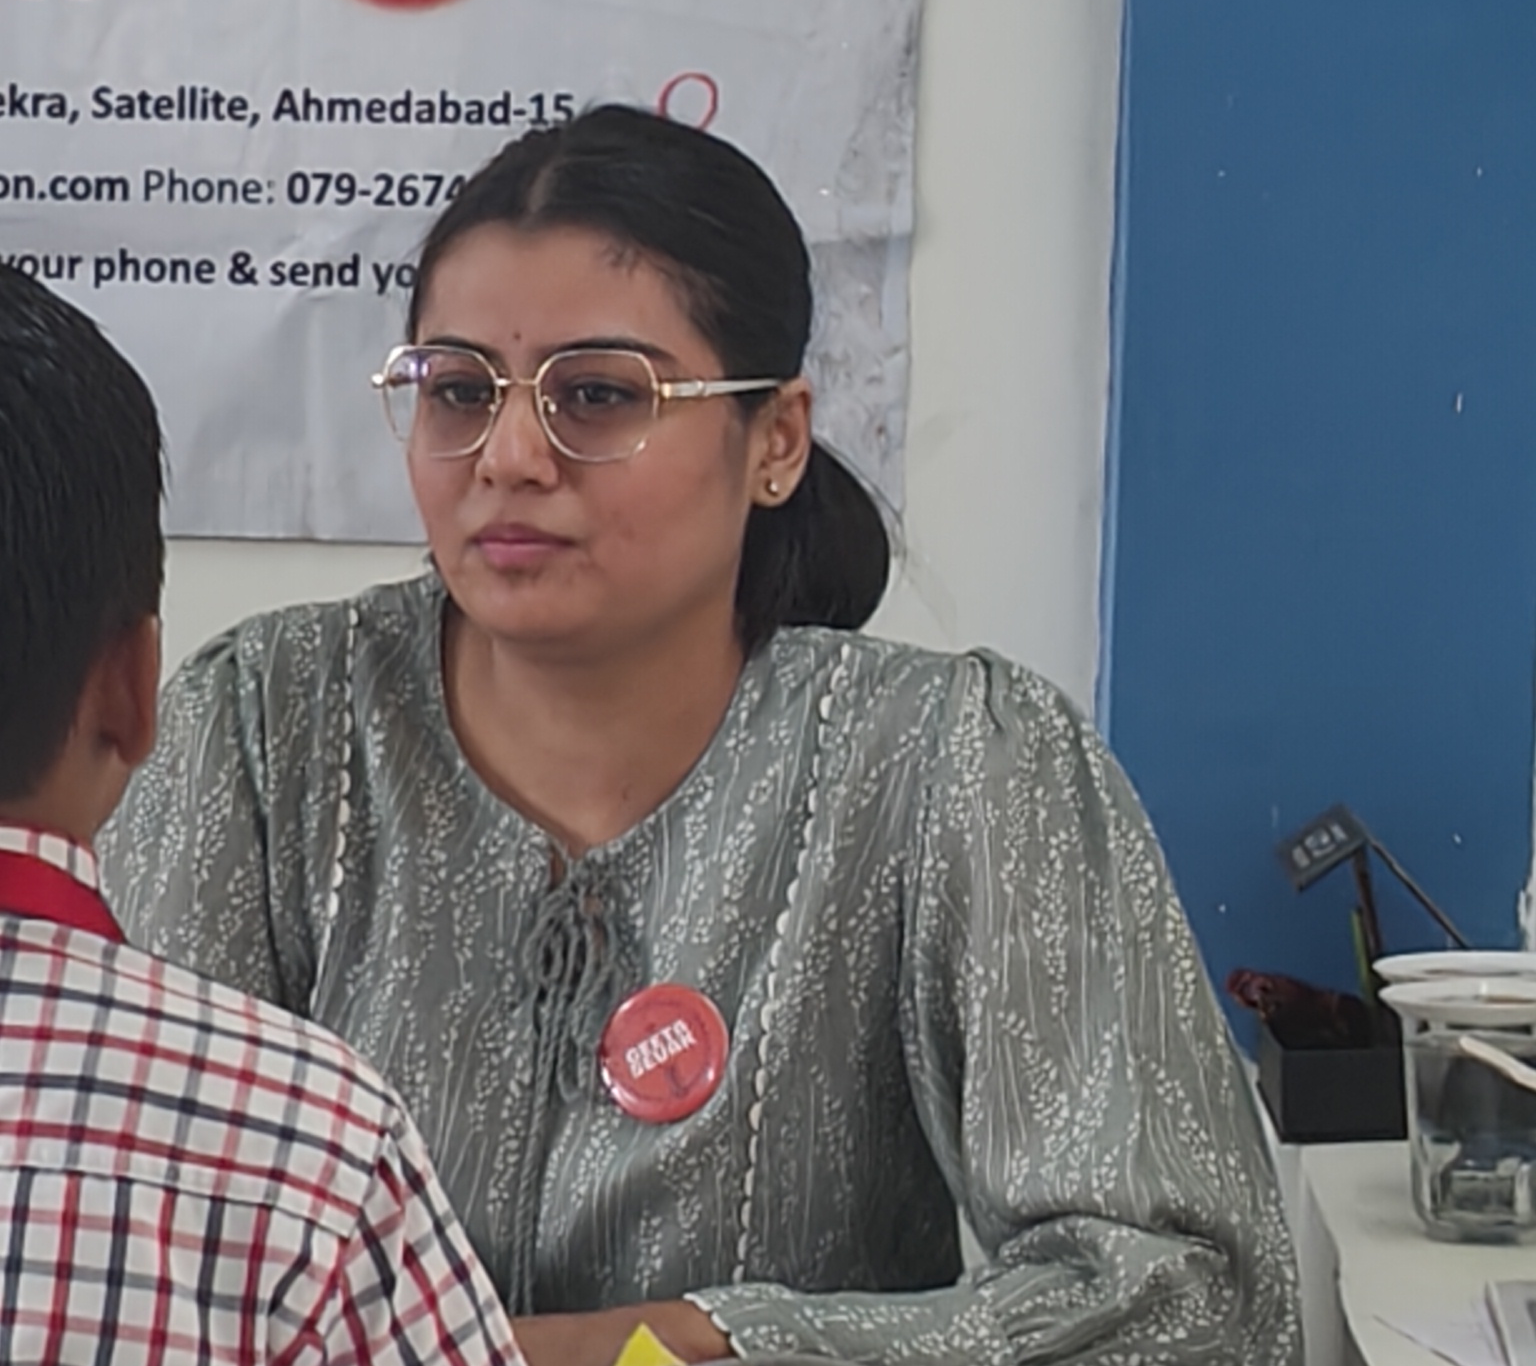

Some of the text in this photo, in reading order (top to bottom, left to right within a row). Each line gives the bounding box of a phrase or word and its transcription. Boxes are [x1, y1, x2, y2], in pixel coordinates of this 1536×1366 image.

[91, 85, 260, 128] Satellite,
[272, 87, 575, 126] Ahmedabad-15
[144, 168, 274, 204] Phone:
[94, 248, 216, 289] phone
[228, 251, 258, 285] &
[270, 252, 361, 288] send
[372, 262, 418, 296] yo
